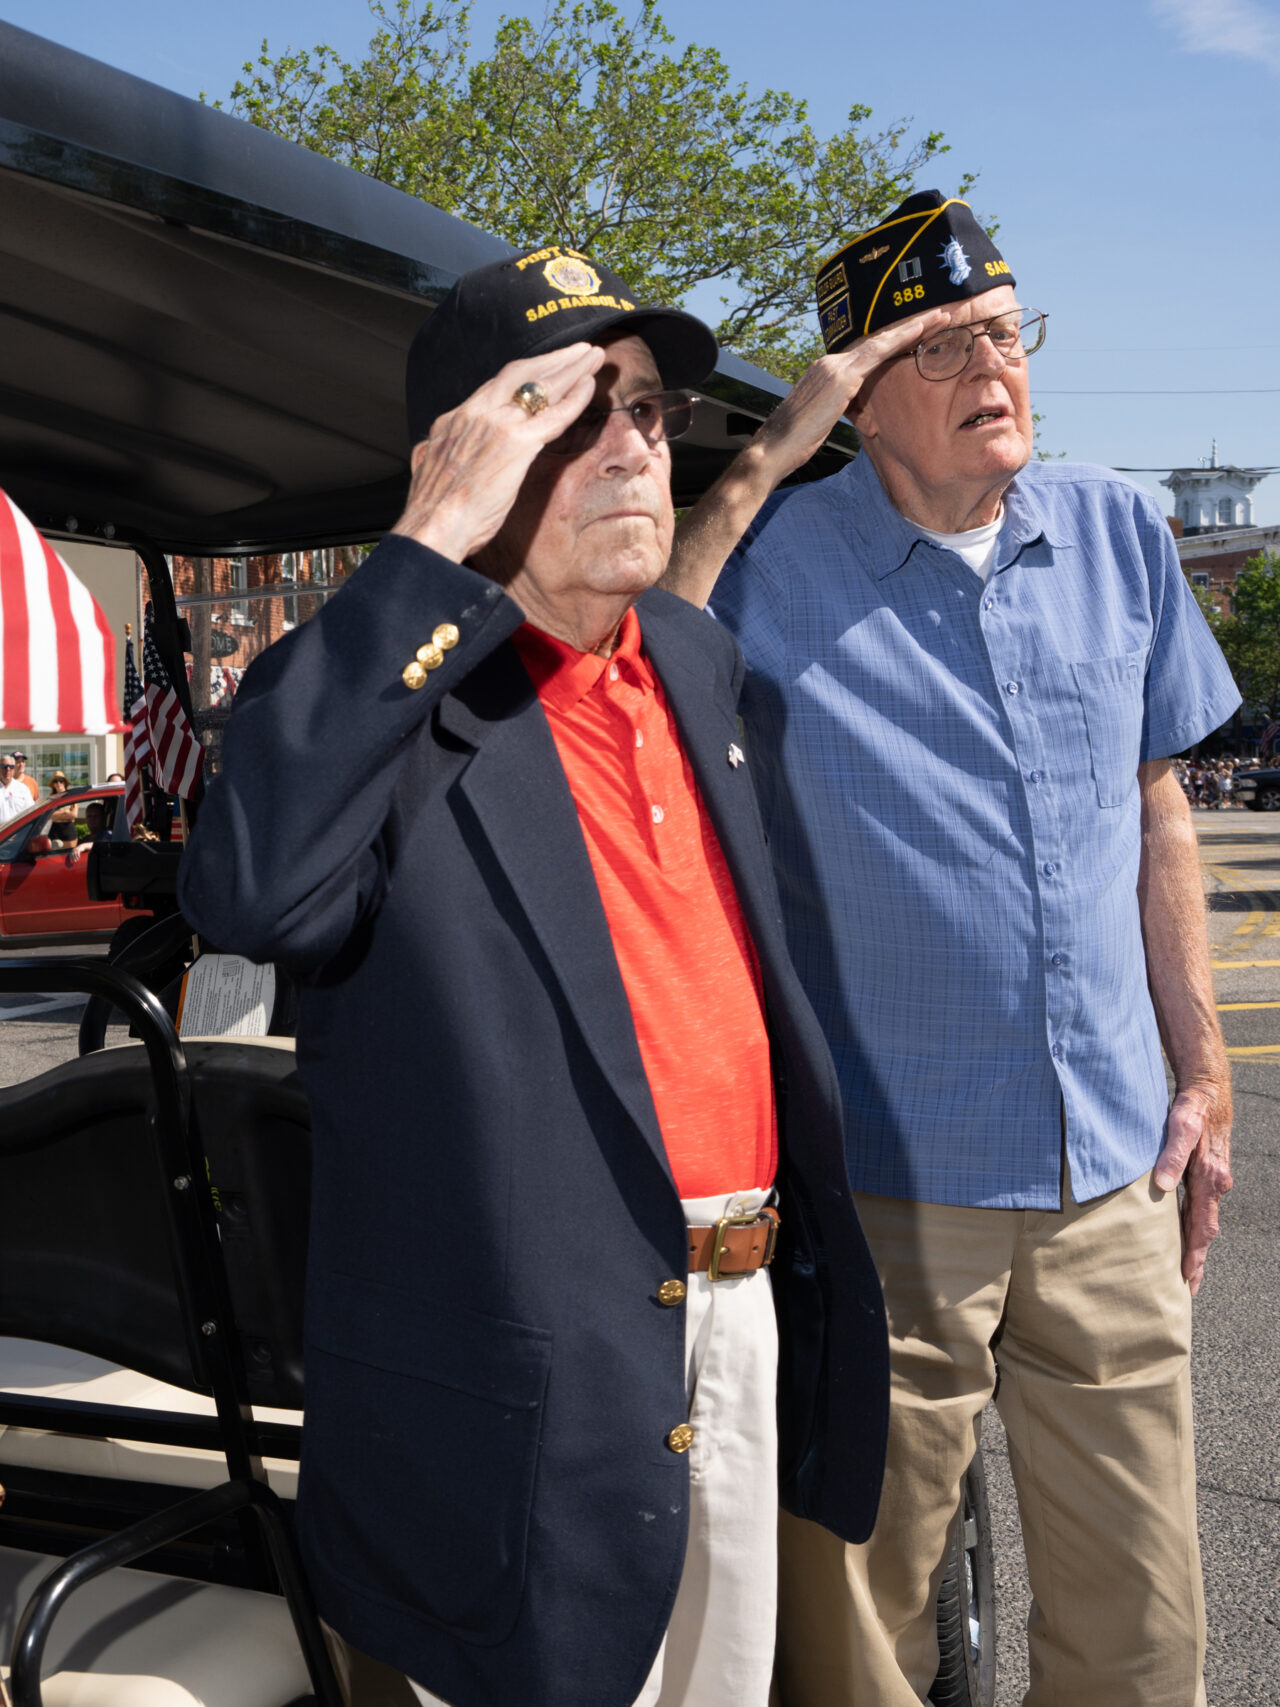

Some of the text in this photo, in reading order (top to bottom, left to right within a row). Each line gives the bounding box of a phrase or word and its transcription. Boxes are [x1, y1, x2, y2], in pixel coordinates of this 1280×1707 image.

[515, 245, 563, 271] POST
[892, 284, 925, 306] 388
[525, 300, 559, 322] SAG
